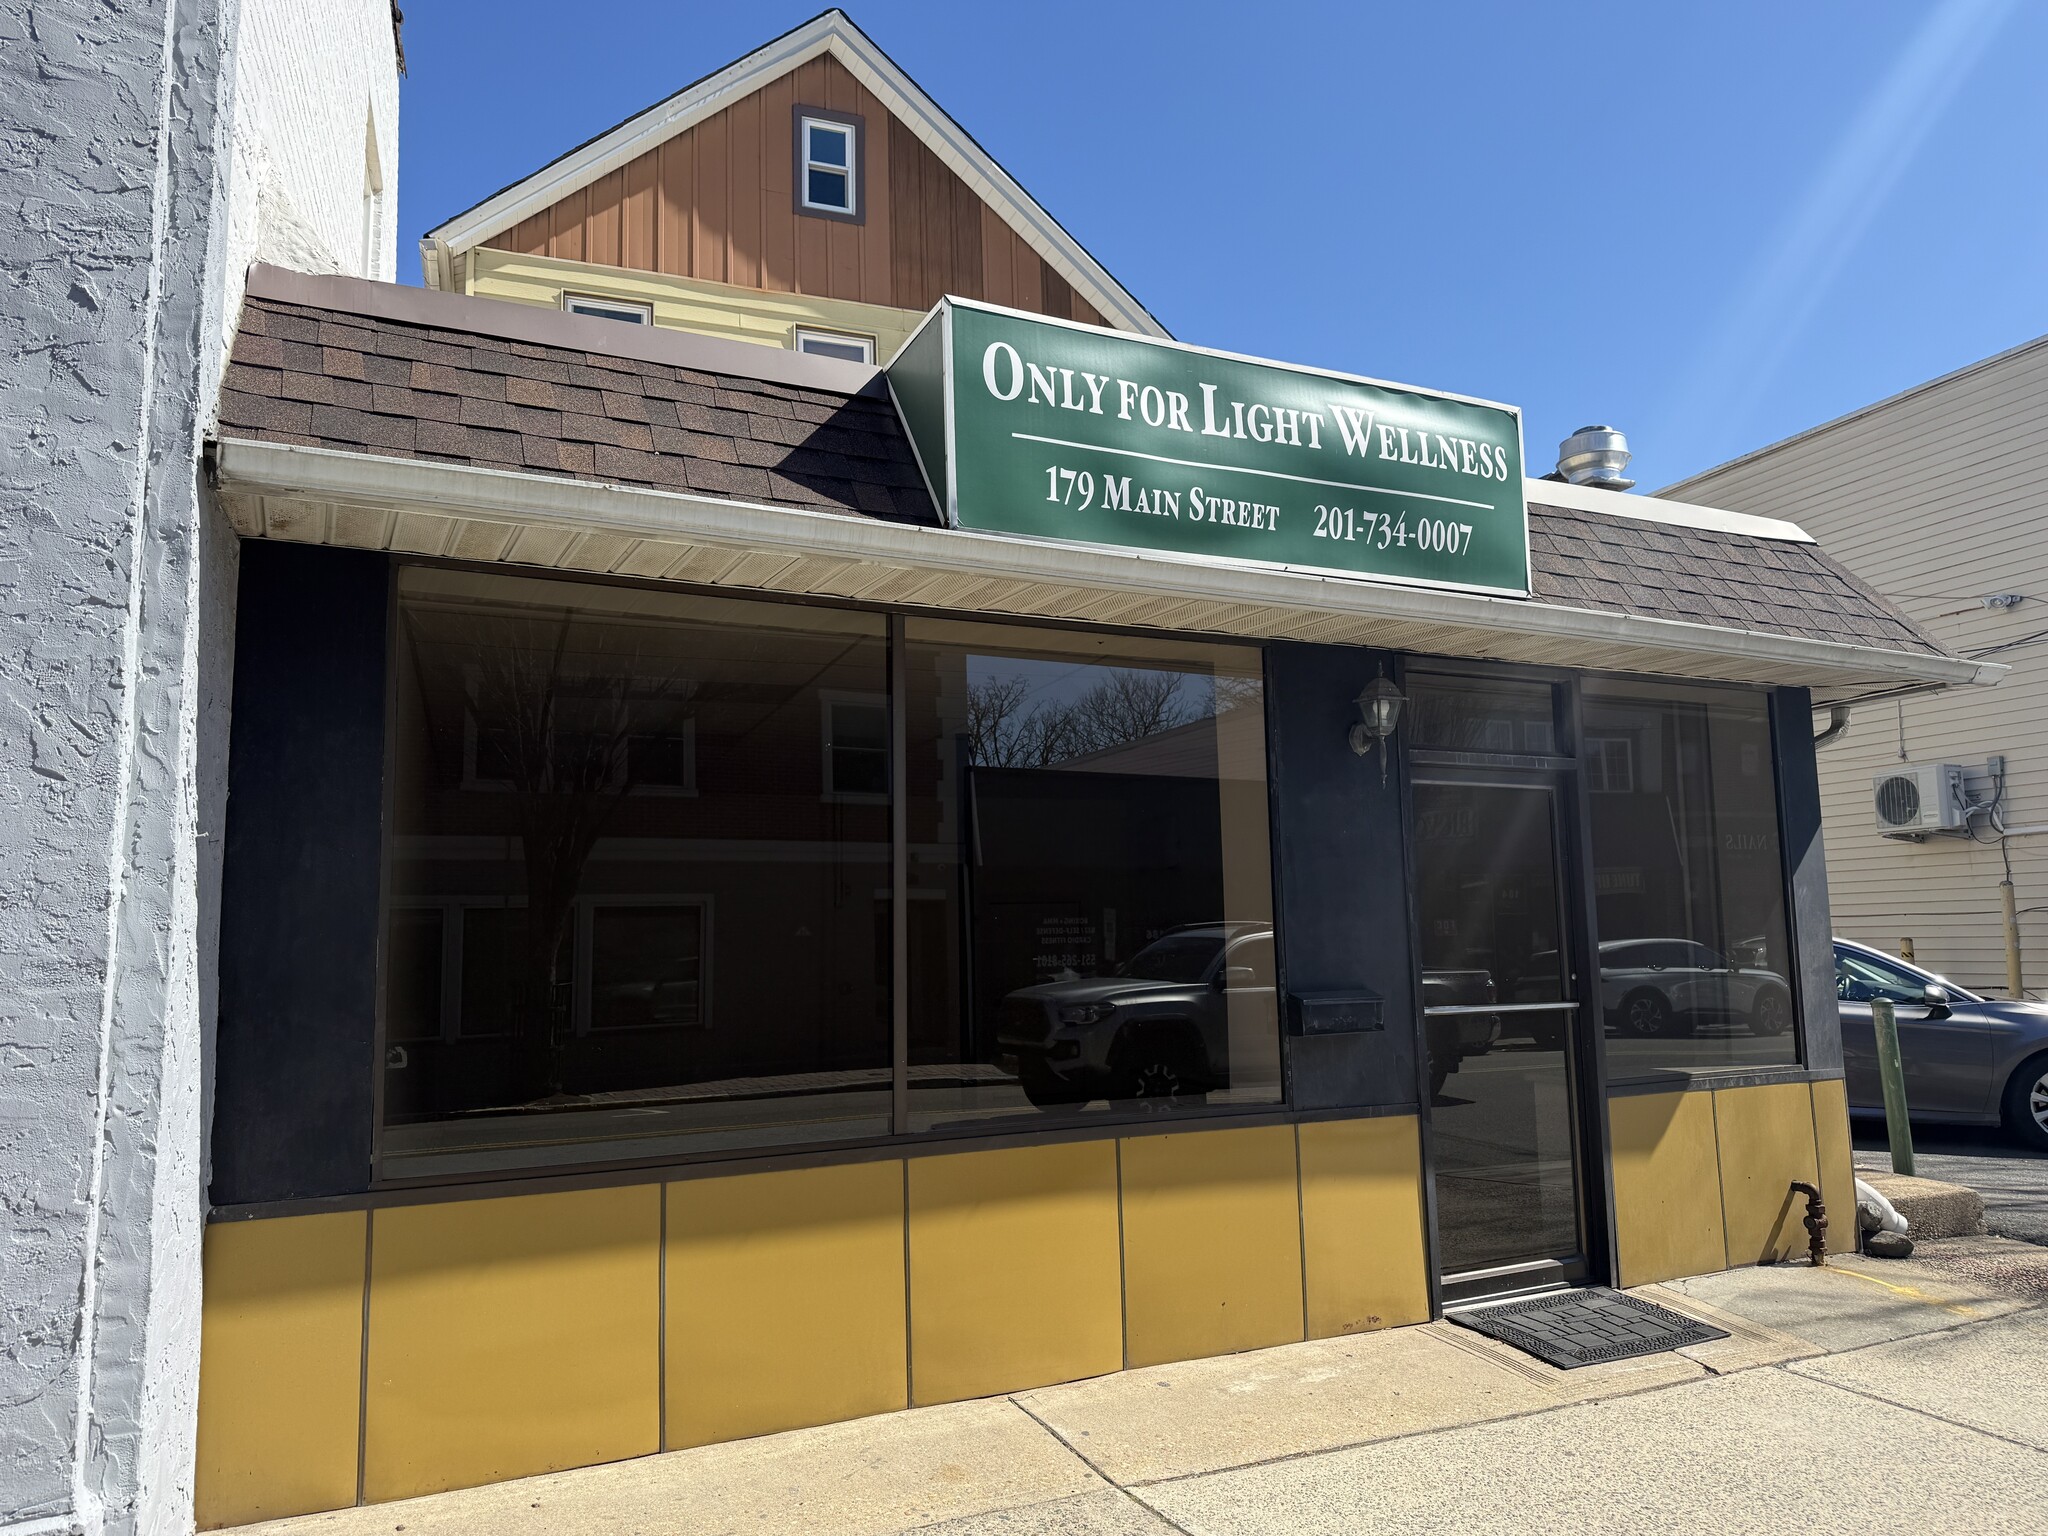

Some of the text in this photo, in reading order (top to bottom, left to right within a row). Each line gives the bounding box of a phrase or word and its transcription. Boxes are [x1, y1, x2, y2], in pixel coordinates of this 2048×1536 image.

[982, 342, 1508, 482] ONLY FOR LIGHT WELLNESS
[1045, 465, 1280, 531] 179 MAIN STREET
[1312, 504, 1473, 556] 201-734-0007
